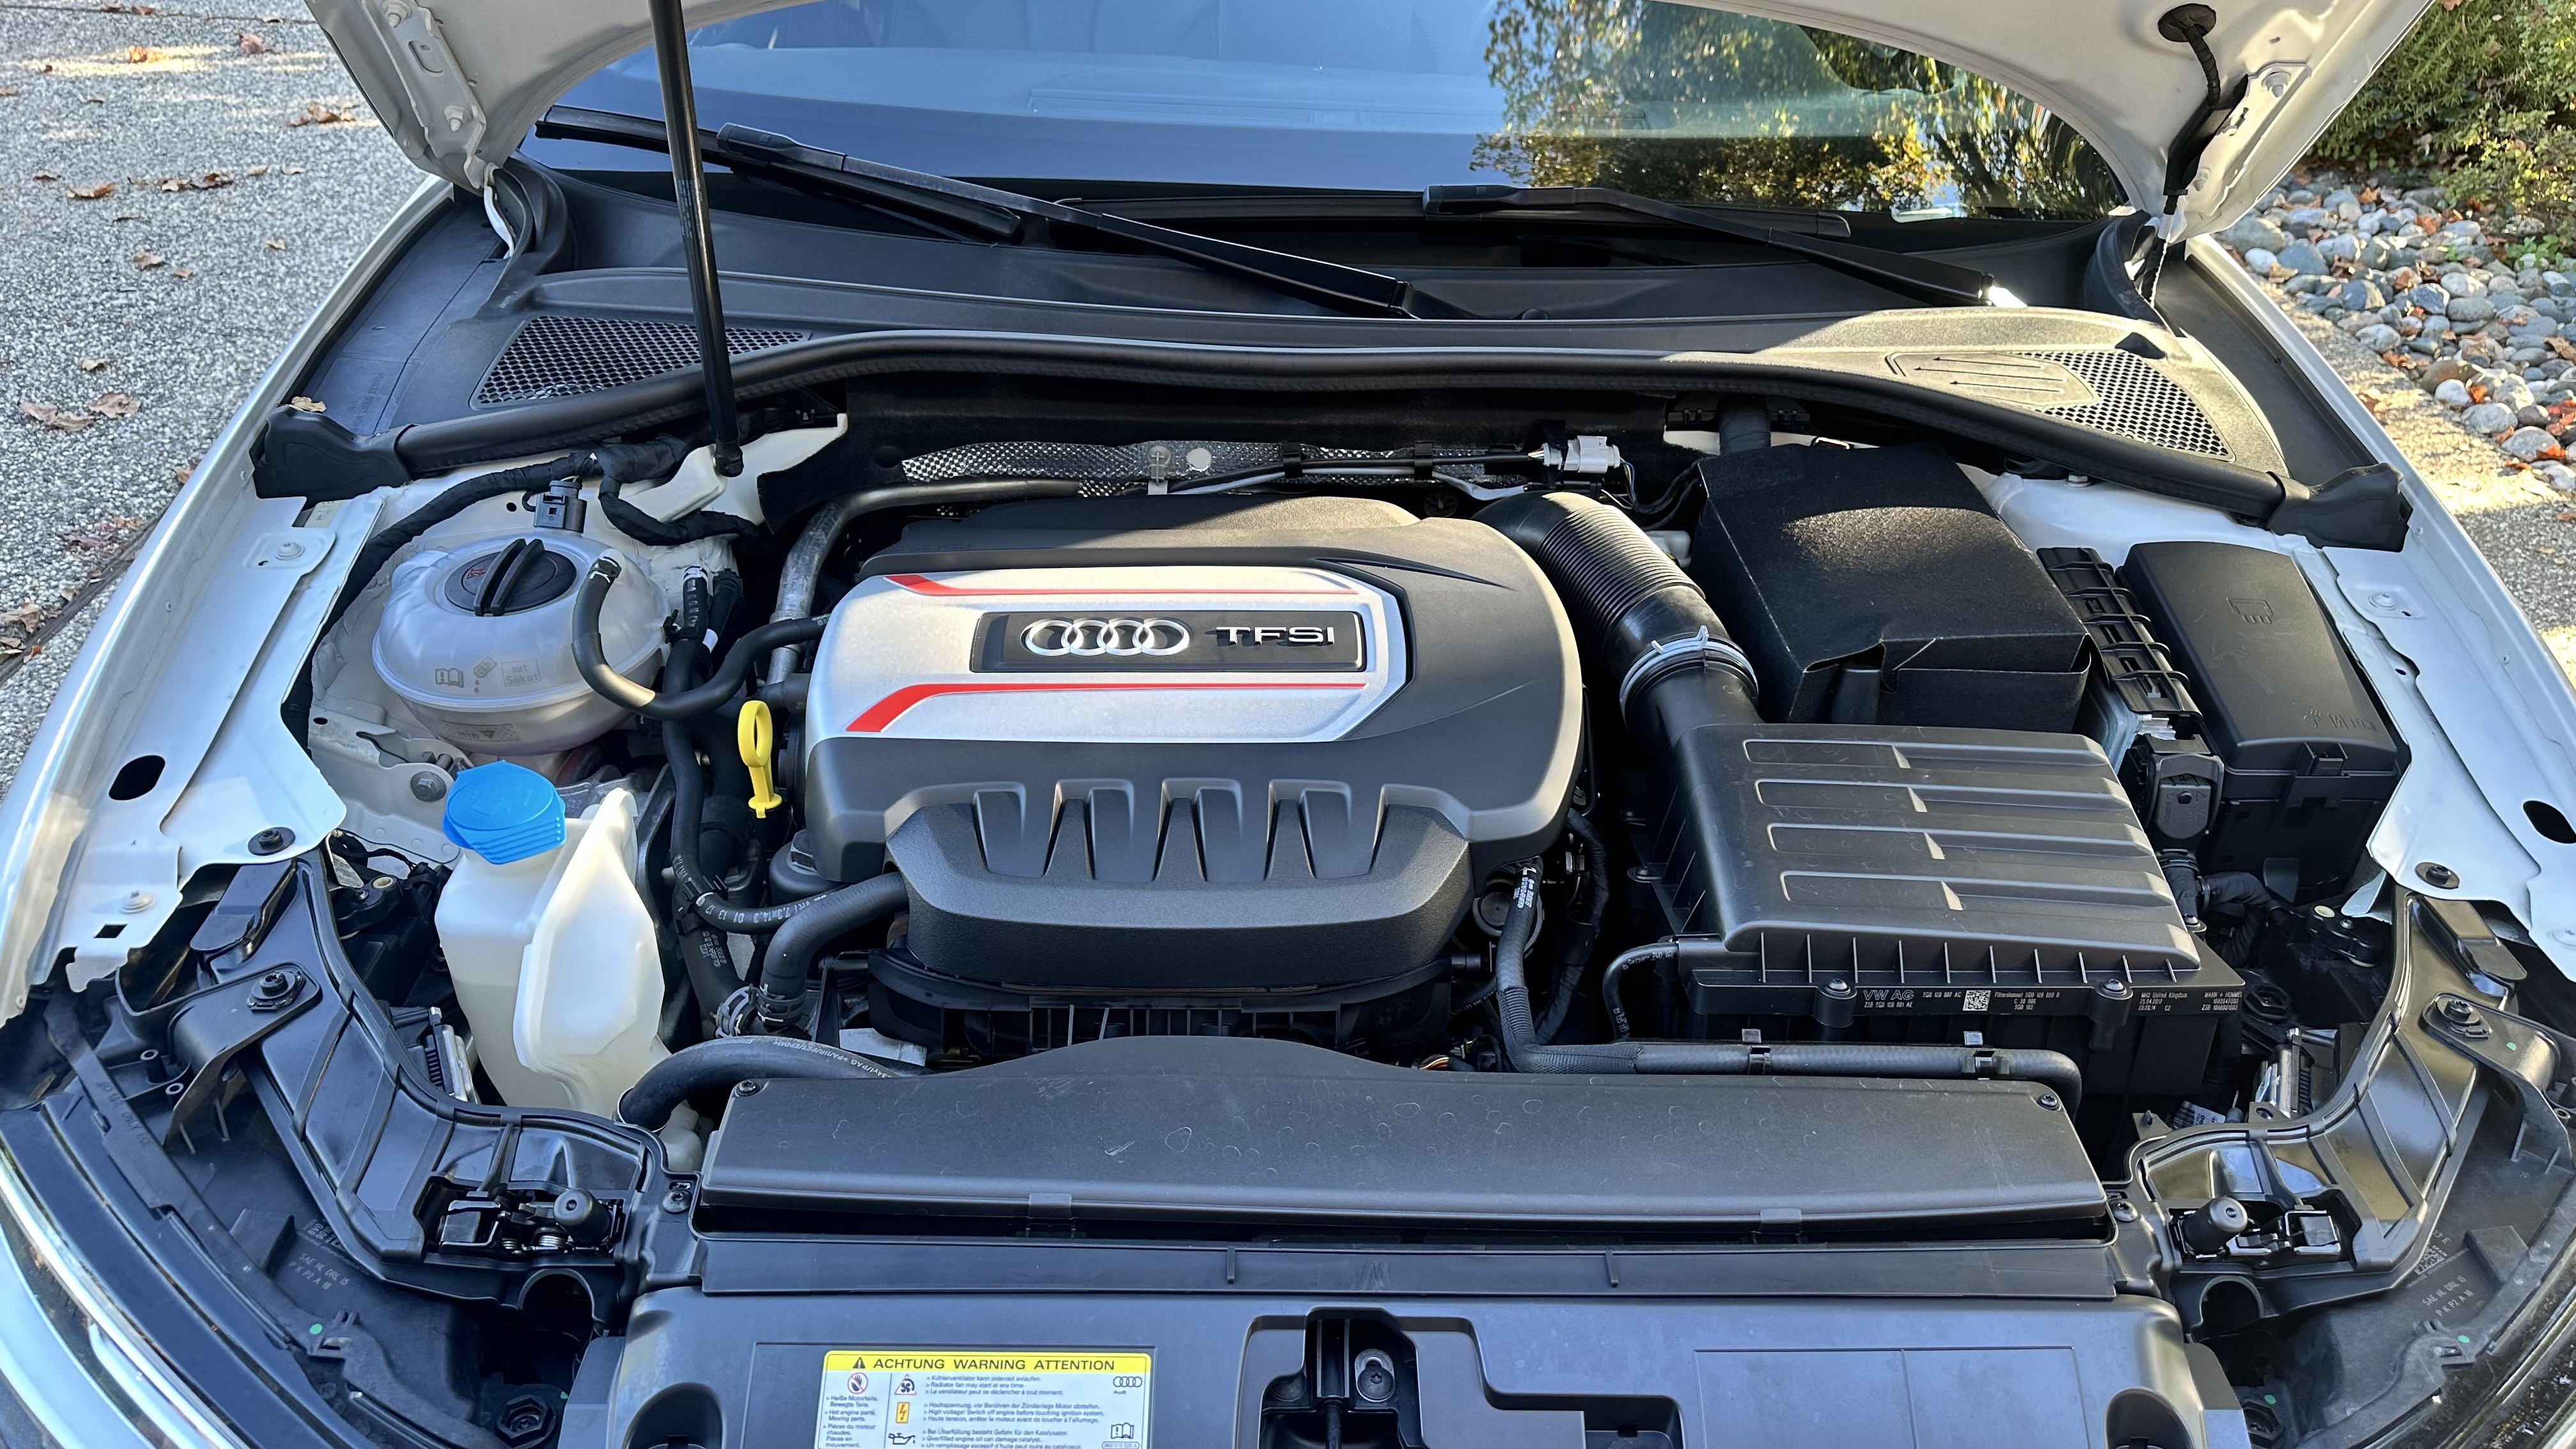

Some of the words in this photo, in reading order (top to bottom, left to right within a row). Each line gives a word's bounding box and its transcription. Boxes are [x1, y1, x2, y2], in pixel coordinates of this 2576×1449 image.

[1216, 626, 1335, 645] TFSI
[512, 664, 528, 673] mit
[505, 675, 539, 684] Silikat
[457, 731, 480, 739] min
[1863, 990, 1889, 1000] VW
[1890, 990, 1914, 1000] AG
[299, 1254, 316, 1265] SAE
[314, 1262, 325, 1271] HL
[325, 1269, 340, 1281] DRL
[303, 1270, 314, 1279] P2
[2422, 1294, 2438, 1306] SAE
[2435, 1289, 2447, 1297] HL
[2444, 1281, 2460, 1291] DRL
[2448, 1299, 2460, 1308] P2
[873, 1359, 945, 1369] ACHTUNG
[953, 1360, 1026, 1370] WARNING
[1033, 1360, 1116, 1370] ATTENTION
